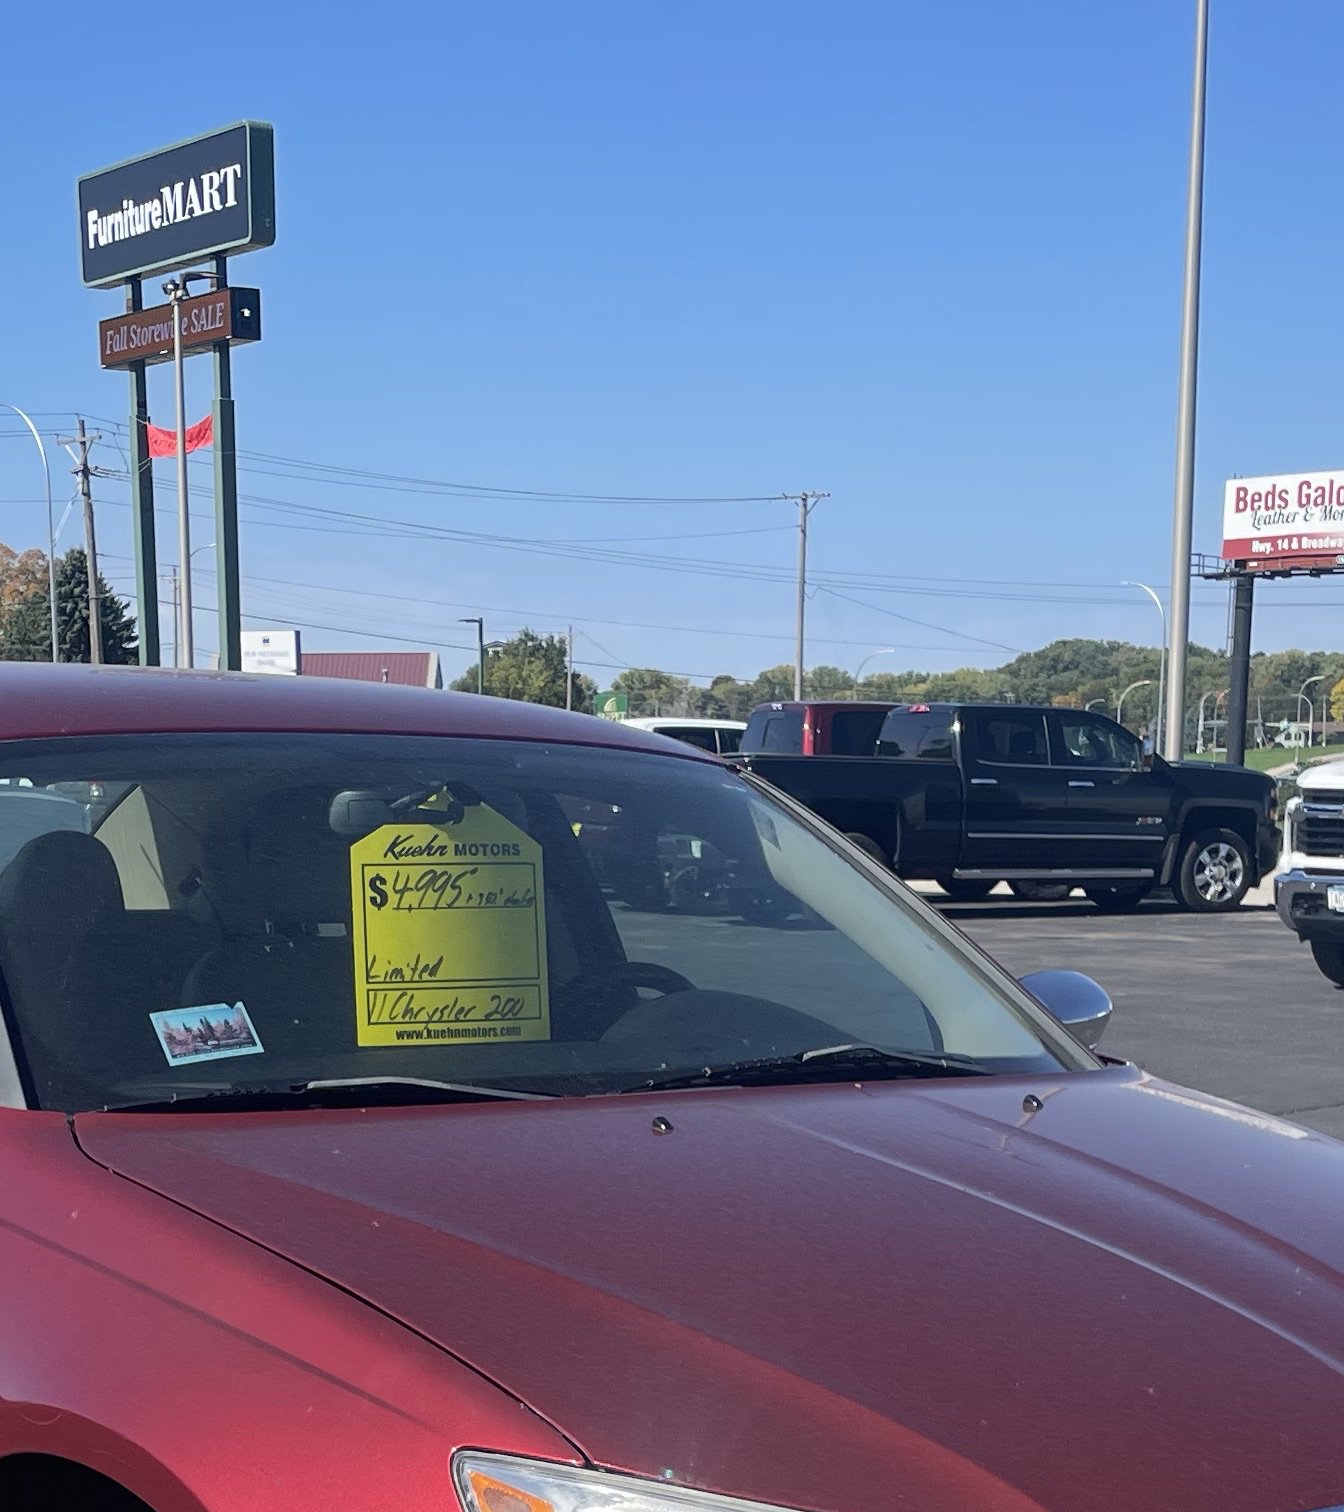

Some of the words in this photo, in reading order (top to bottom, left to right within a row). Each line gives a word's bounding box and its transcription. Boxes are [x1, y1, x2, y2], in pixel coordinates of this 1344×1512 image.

[87, 164, 241, 249] FurnitureMART
[106, 325, 128, 354] Fall
[130, 314, 187, 349] Storewie
[191, 302, 224, 334] SALE
[1235, 484, 1289, 514] Beds
[1251, 508, 1298, 530] Leather
[1303, 506, 1316, 522] &
[1251, 540, 1274, 555] Hwy.
[1277, 538, 1289, 551] 14
[1291, 537, 1299, 550] &
[384, 834, 448, 860] Kuehn
[453, 843, 521, 857] MOTORS
[368, 953, 444, 982] Limited
[389, 992, 476, 1028] Chrysler
[484, 994, 525, 1020] 200
[396, 1026, 522, 1041] www.kuehnmotors.com
